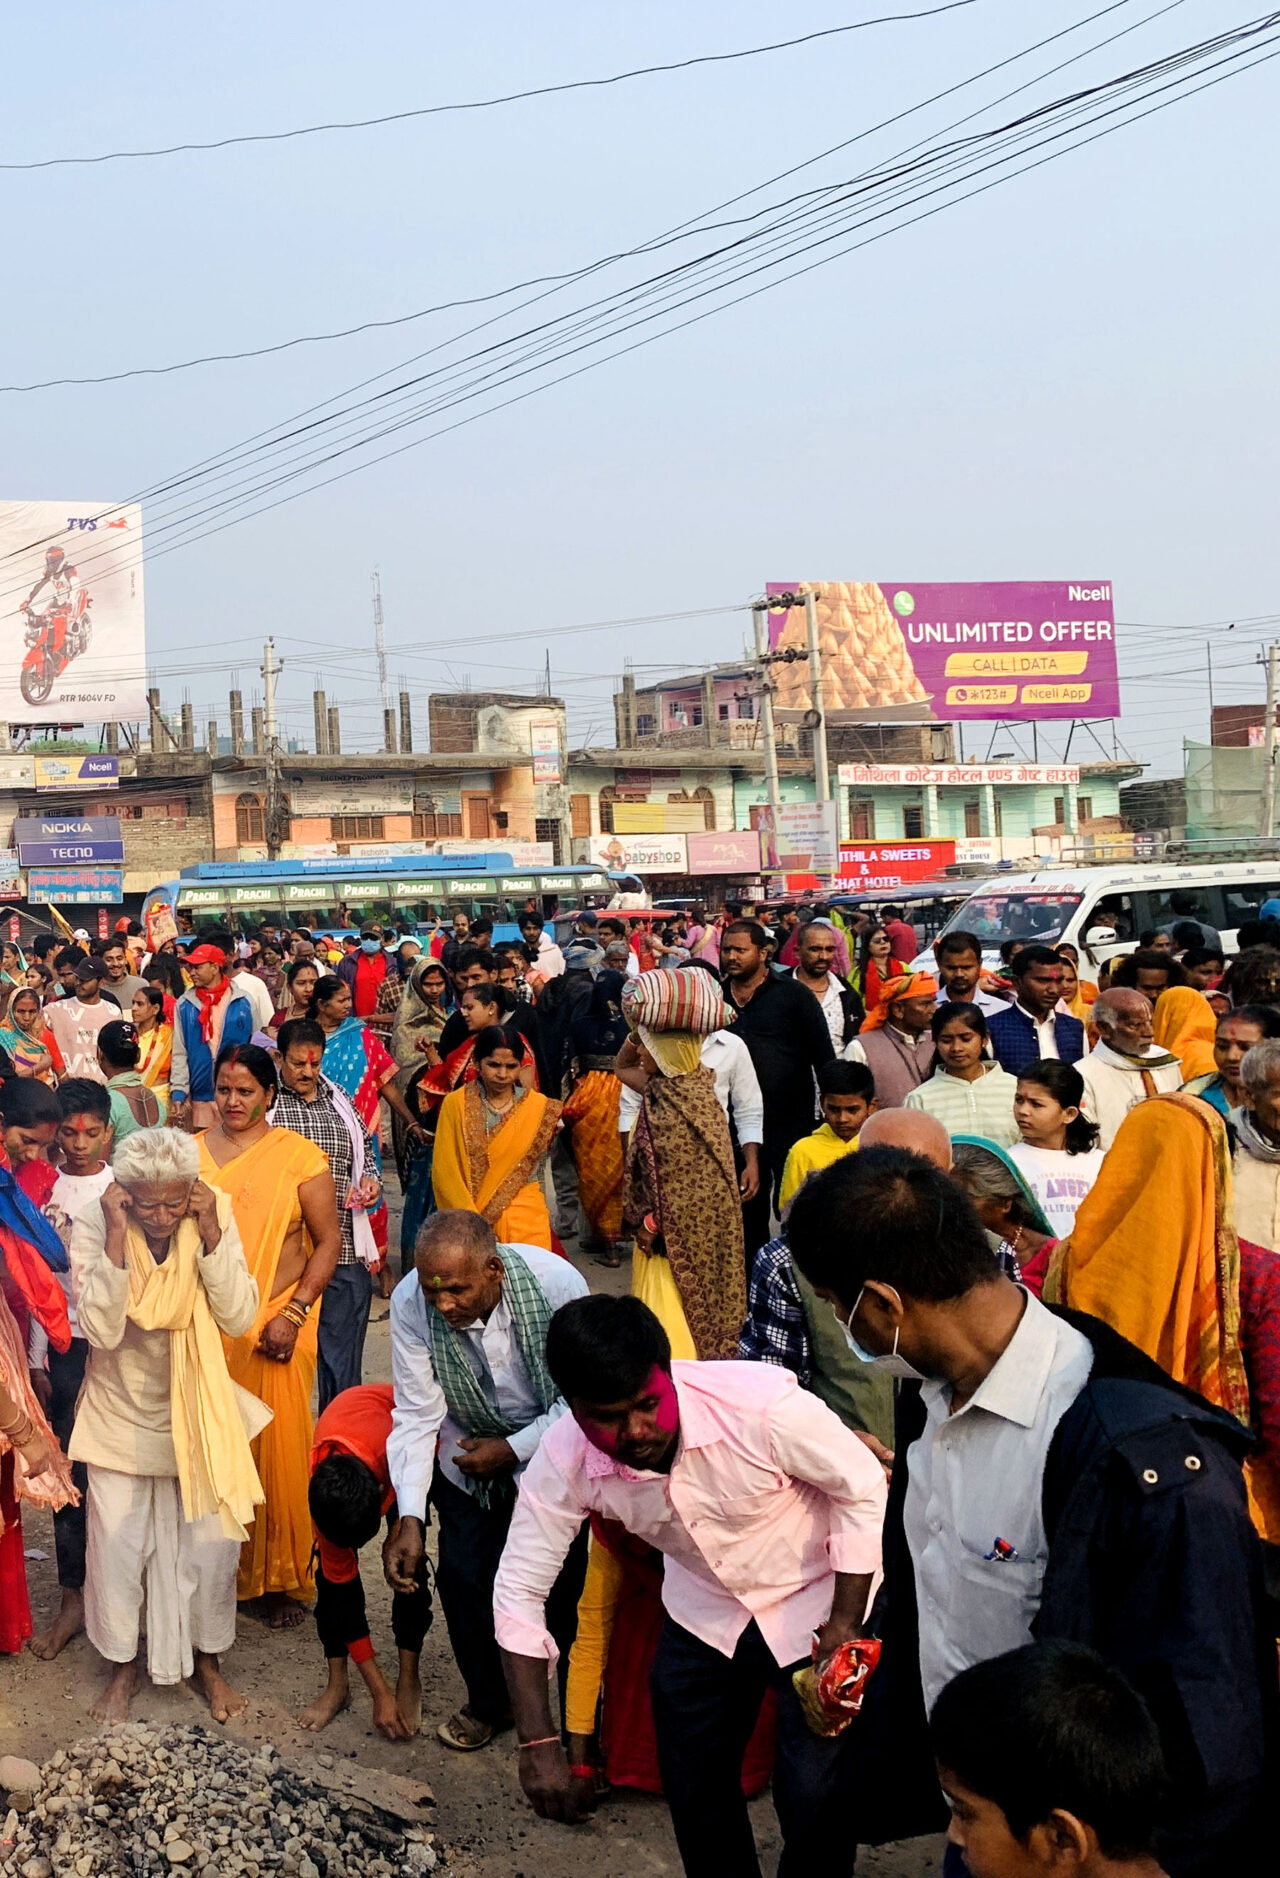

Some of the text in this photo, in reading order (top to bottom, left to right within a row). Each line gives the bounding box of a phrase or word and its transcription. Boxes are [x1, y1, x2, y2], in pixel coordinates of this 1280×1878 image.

[67, 518, 98, 531] TVS
[1068, 585, 1110, 602] Ncell
[908, 620, 1113, 644] UNLIMITED OFFER
[972, 657, 1058, 672] CALL DATA
[59, 694, 77, 703] RTR
[104, 693, 116, 703] FD
[1028, 687, 1086, 701] Ncell App
[88, 762, 112, 772] Ncell
[853, 766, 901, 783] मिथिला
[905, 766, 943, 783] कोटेज
[947, 766, 983, 783] होटल
[987, 769, 1013, 782] एण्ड
[1046, 768, 1079, 783] हाउस
[41, 822, 93, 834] NOKIA
[50, 847, 93, 859] TECNO
[624, 850, 682, 863] babyshop
[881, 848, 932, 862] SWEETS
[860, 864, 870, 875] &
[397, 882, 434, 894] PRACHI
[451, 880, 487, 892] PRACHI
[502, 878, 533, 890] PRACHI
[541, 876, 572, 889] PRACHI
[236, 888, 271, 900] PRACHI
[289, 885, 326, 898] PRACHI
[344, 883, 380, 896] PRACHI
[185, 891, 219, 902] PRACHI
